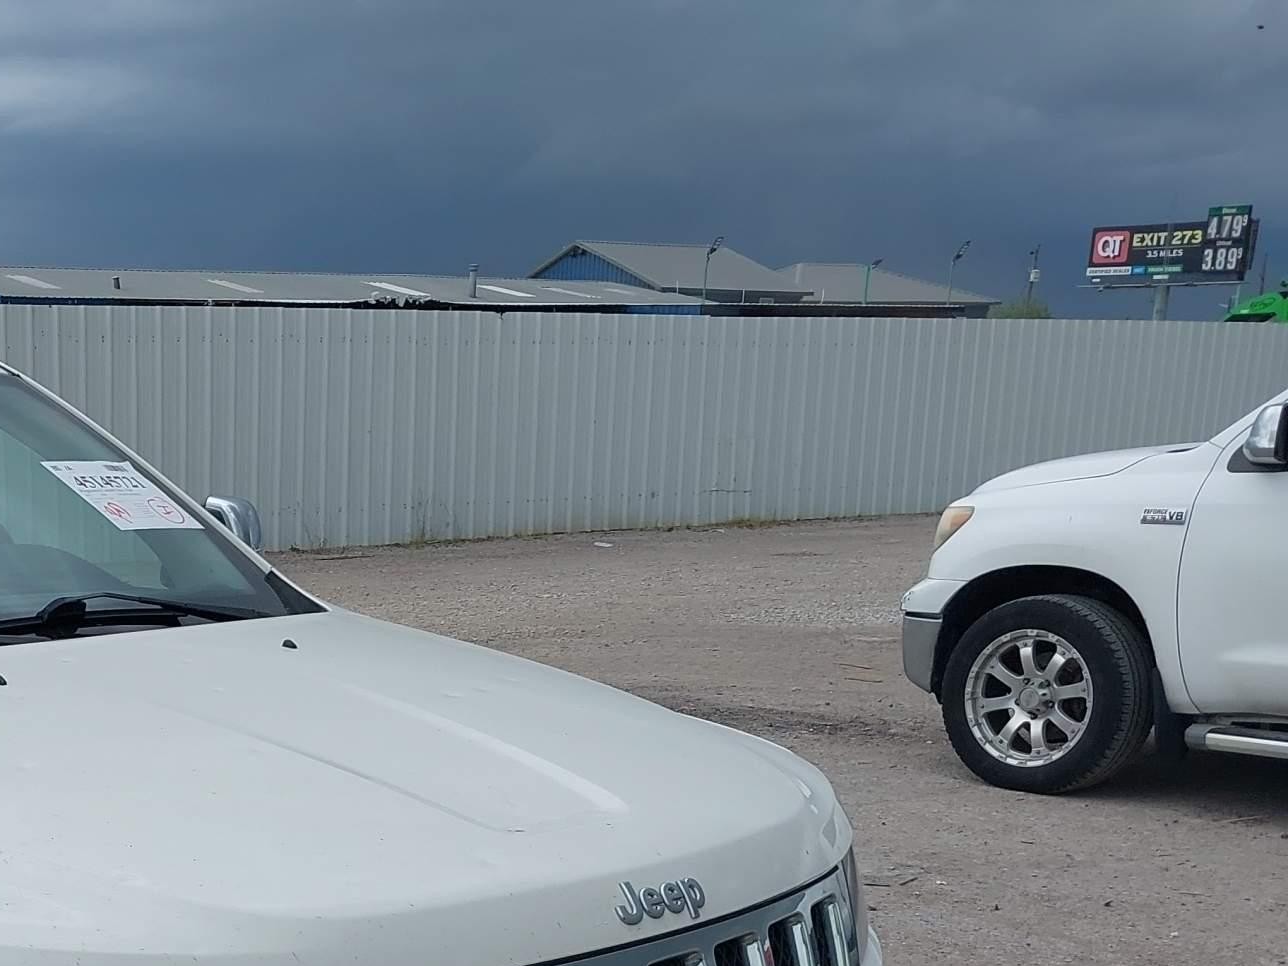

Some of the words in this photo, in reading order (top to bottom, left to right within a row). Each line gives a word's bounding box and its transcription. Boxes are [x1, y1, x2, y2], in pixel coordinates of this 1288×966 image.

[1133, 232, 1168, 247] EXIT
[1172, 230, 1202, 245] 273
[1097, 236, 1124, 258] QT
[1159, 249, 1184, 257] MILES
[73, 475, 147, 489] 45145721
[1168, 511, 1184, 520] V8
[615, 878, 705, 925] Jeep
